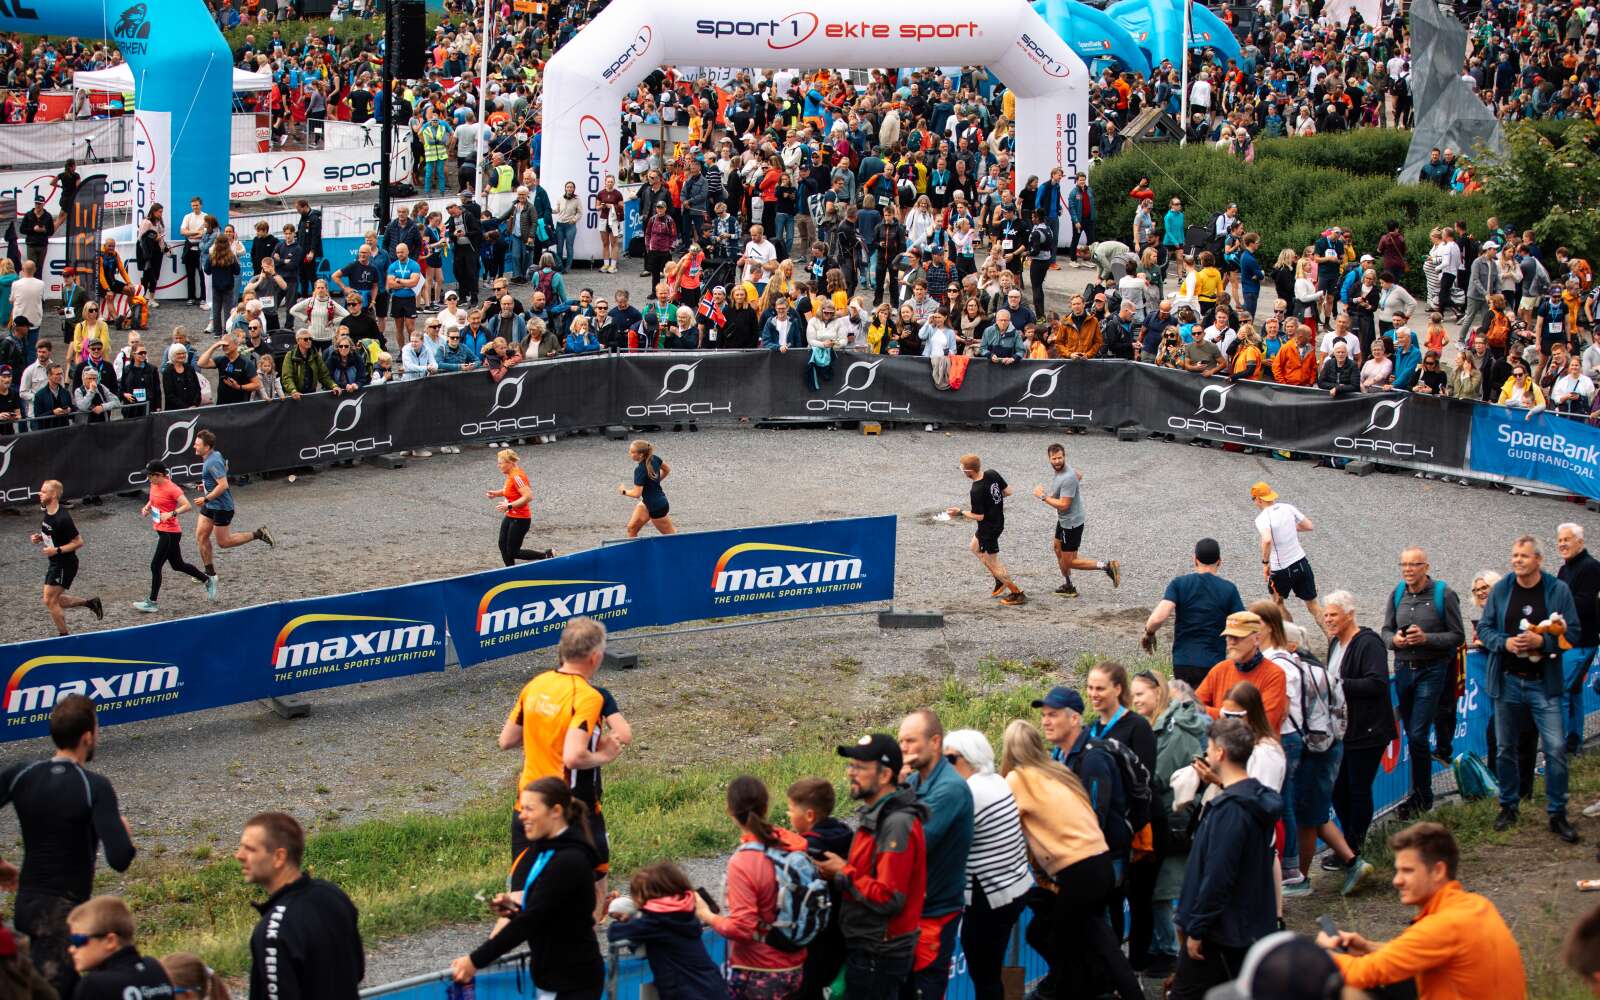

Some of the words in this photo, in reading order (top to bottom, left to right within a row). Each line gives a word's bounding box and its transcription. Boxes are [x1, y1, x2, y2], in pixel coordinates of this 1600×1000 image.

[697, 20, 779, 38] sport
[792, 21, 799, 37] 1
[825, 22, 890, 38] ekte
[899, 22, 978, 42] sport
[603, 44, 637, 79] sport
[1021, 34, 1054, 64] sport
[1064, 113, 1077, 185] sport
[230, 168, 272, 185] port
[324, 161, 381, 182] spor
[587, 152, 601, 229] sport
[1497, 424, 1600, 465] SpareBank
[714, 558, 862, 593] maxim
[714, 596, 731, 604] THE
[733, 591, 775, 602] ORIGINAL
[778, 587, 813, 598] SPORTS
[815, 582, 863, 593] NUTRITION
[480, 584, 626, 636] maxim
[480, 637, 496, 648] THE
[498, 629, 540, 644] ORIGINAL
[543, 621, 568, 633] SPOR
[591, 608, 628, 622] TRITION
[275, 624, 435, 670] maxim
[275, 672, 293, 682] THE
[296, 661, 341, 678] ORIGINAL
[343, 656, 381, 670] SPORTS
[384, 649, 436, 664] NUTRITION
[7, 666, 179, 713] maxim
[7, 716, 26, 726] THE
[96, 700, 122, 711] ORTS
[126, 692, 179, 708] NUTRITION
[266, 905, 286, 939] PEAK
